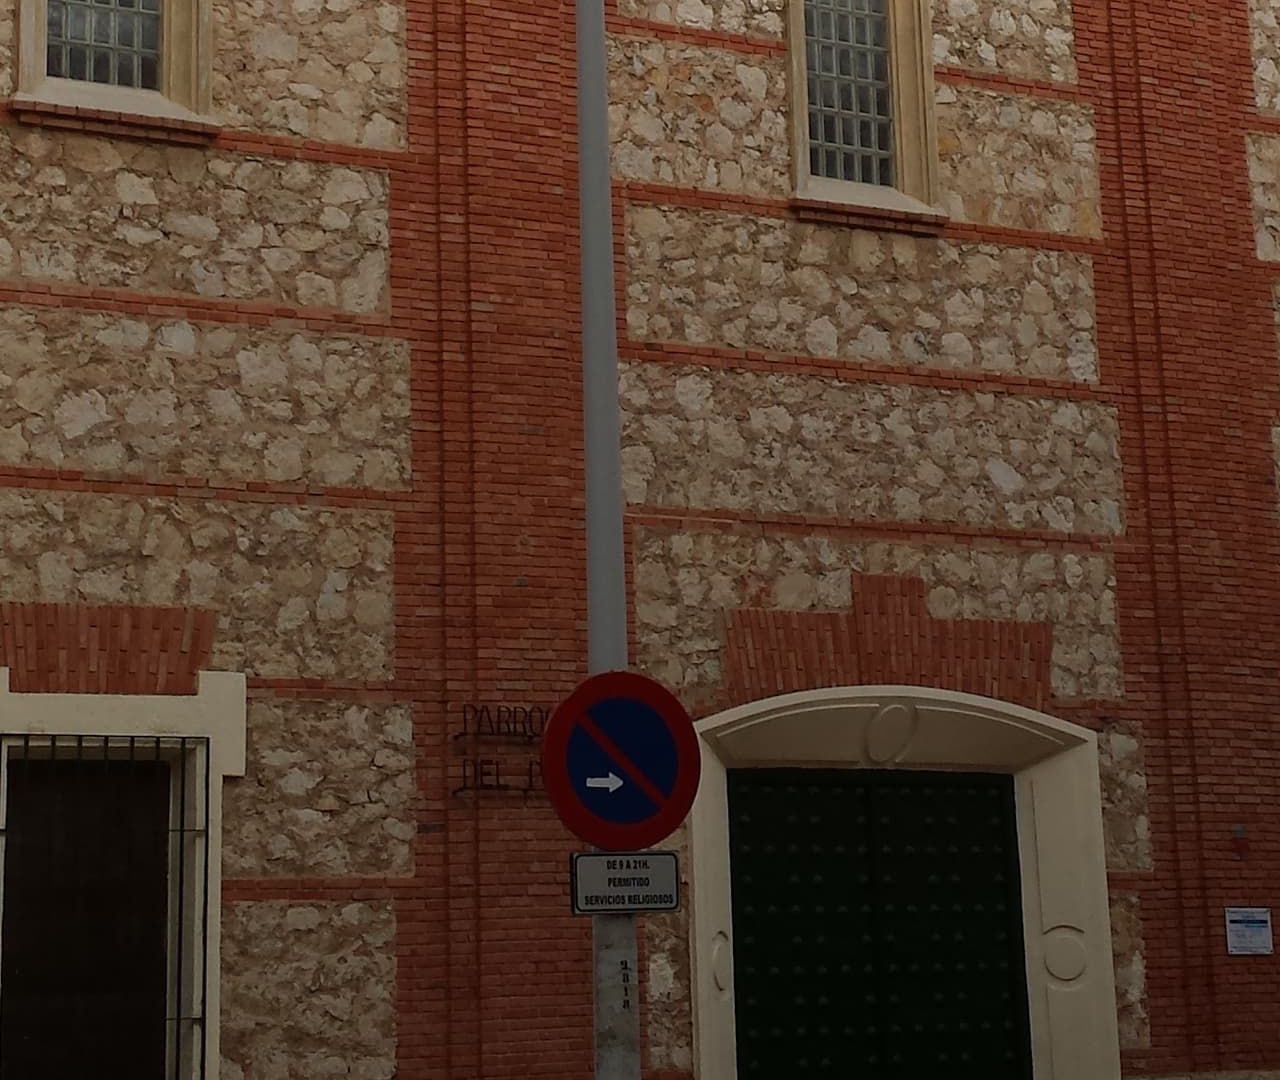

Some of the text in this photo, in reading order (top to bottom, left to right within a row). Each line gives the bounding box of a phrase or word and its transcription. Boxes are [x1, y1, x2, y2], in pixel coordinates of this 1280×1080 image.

[463, 704, 549, 736] PARRO
[606, 860, 617, 870] DE
[607, 877, 650, 888] PERMITIDO
[584, 894, 674, 906] SERVICIOS RELIGIOSOS
